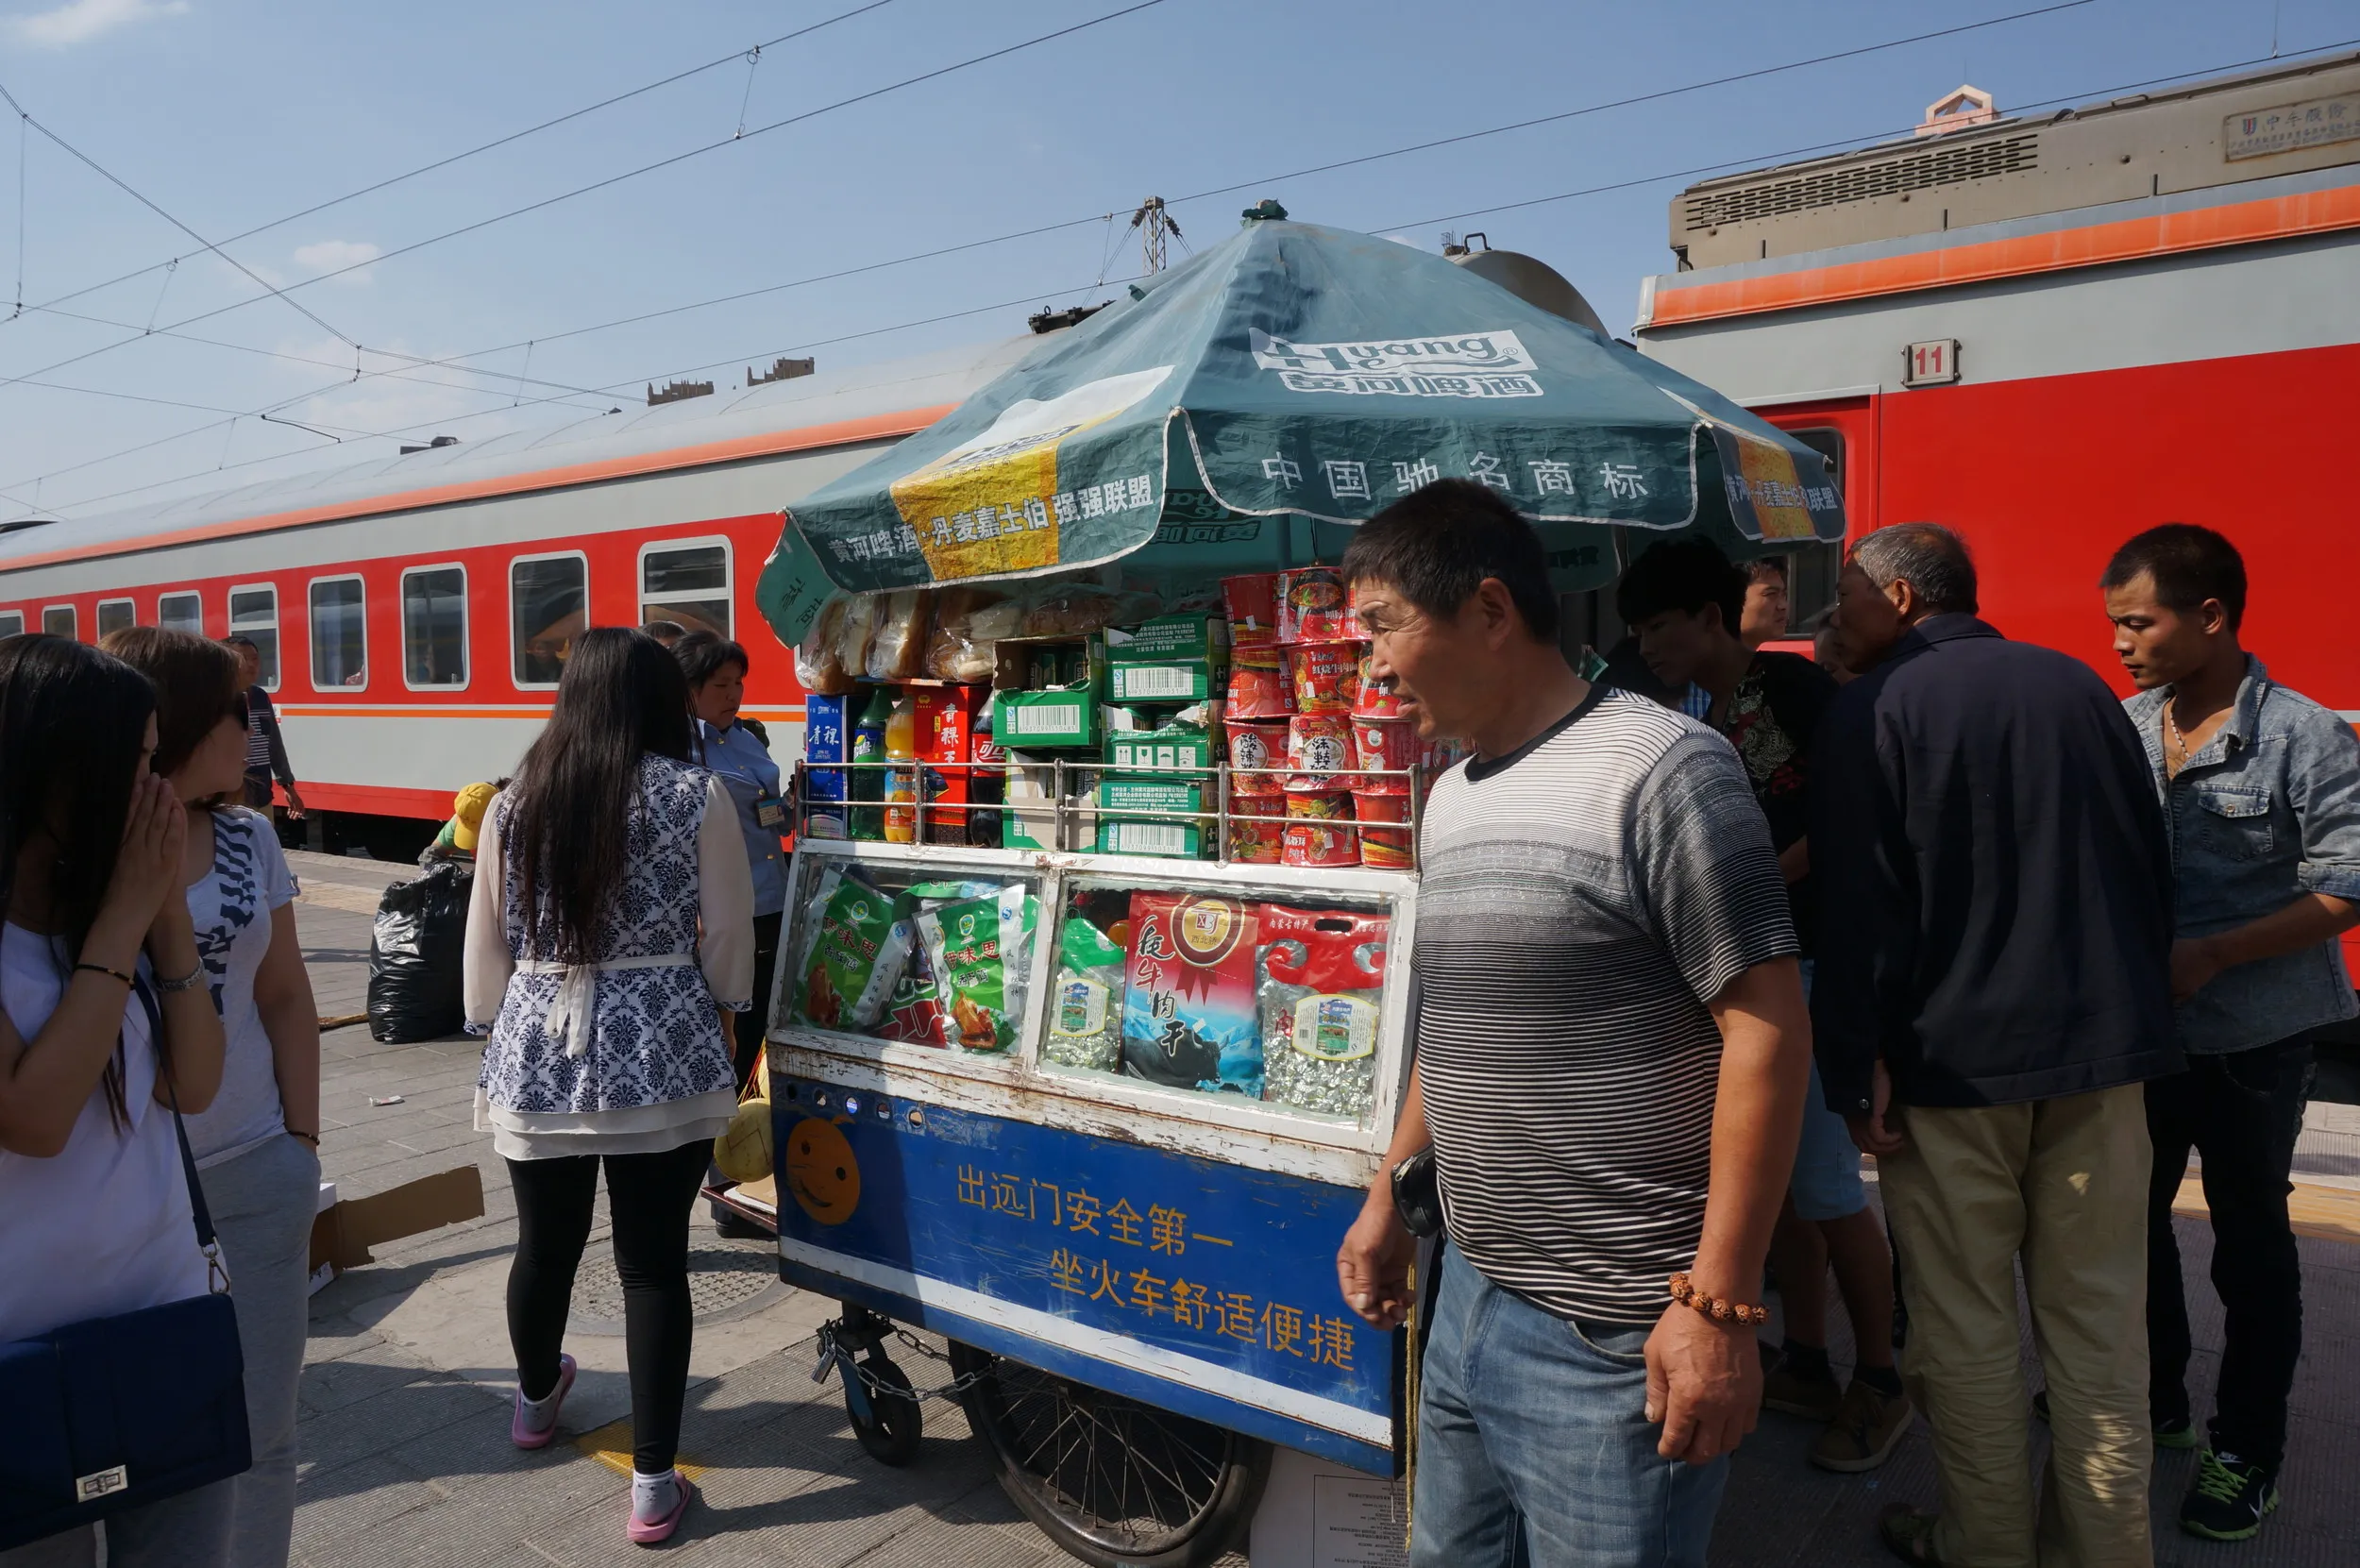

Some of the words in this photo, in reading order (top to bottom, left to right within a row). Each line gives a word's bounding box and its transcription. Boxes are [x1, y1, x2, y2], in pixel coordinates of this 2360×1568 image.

[1914, 346, 1942, 376] 11
[1261, 450, 1649, 501] 中国驰名商标
[957, 1163, 1234, 1256] 出远门安全第一
[1050, 1247, 1357, 1373] 坐火车舒适便捷
